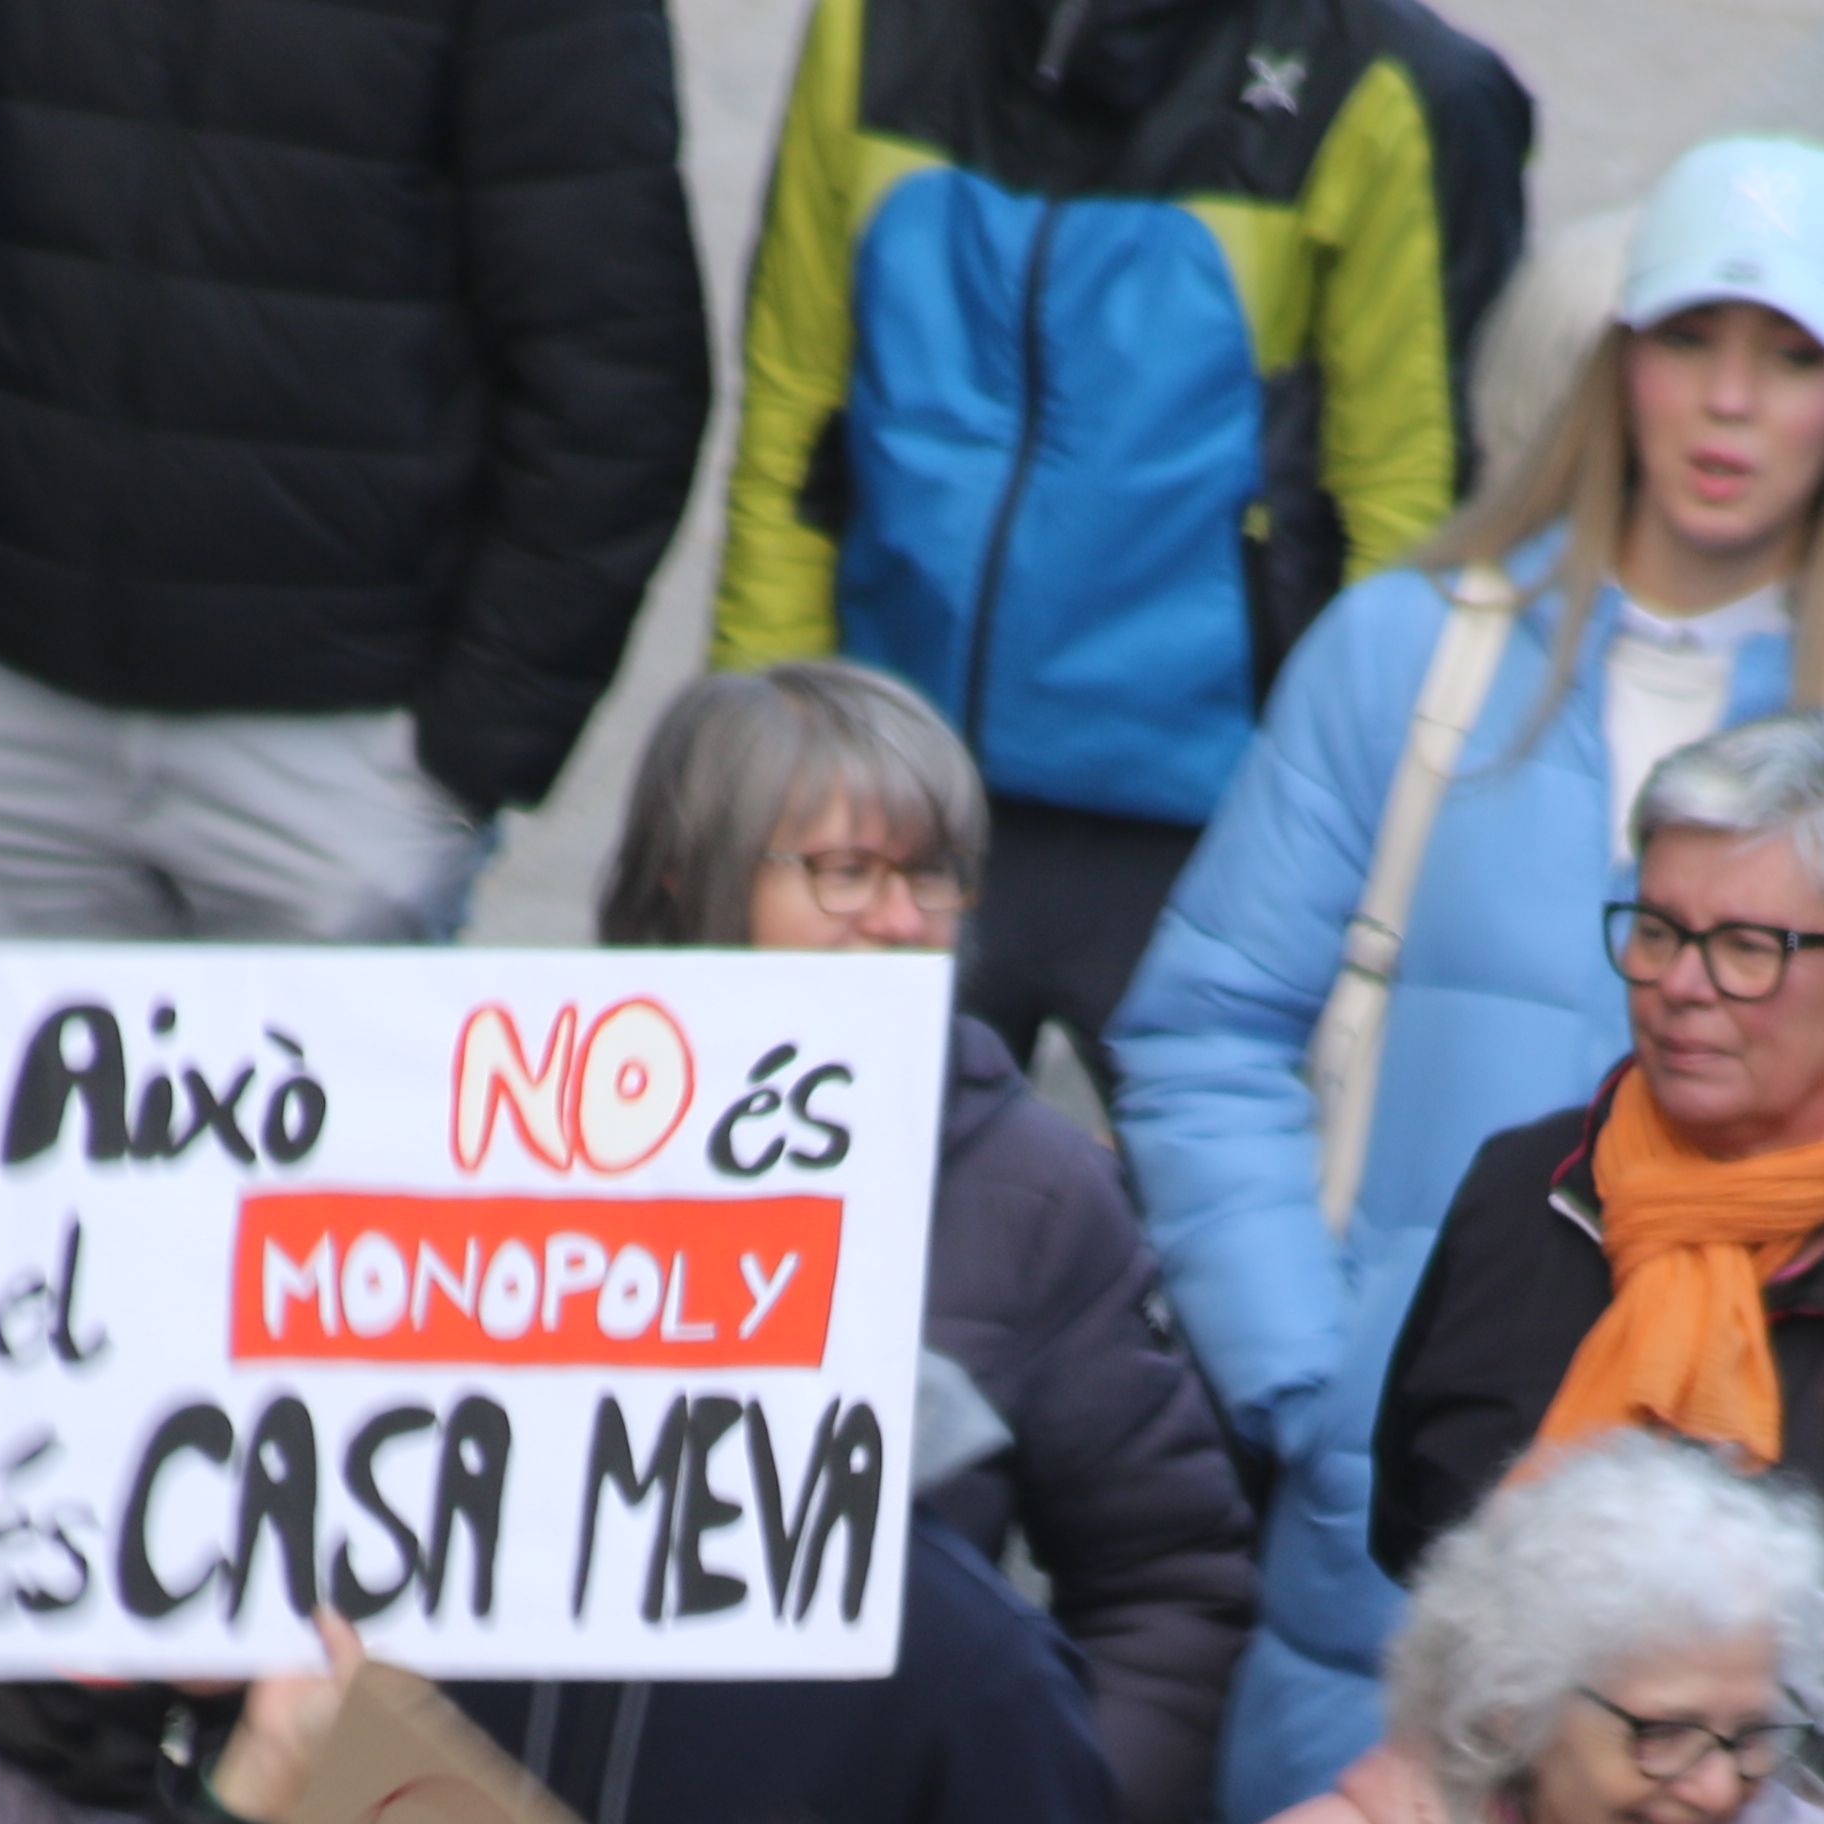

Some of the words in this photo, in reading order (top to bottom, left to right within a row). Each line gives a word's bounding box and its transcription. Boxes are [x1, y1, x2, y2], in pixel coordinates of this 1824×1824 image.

[1, 1003, 326, 1163] Això
[452, 995, 695, 1176] NO
[708, 1043, 852, 1176] és
[263, 1231, 799, 1341] MONOPOLY
[114, 1394, 511, 1621] CASA
[573, 1394, 883, 1624] MEVA
